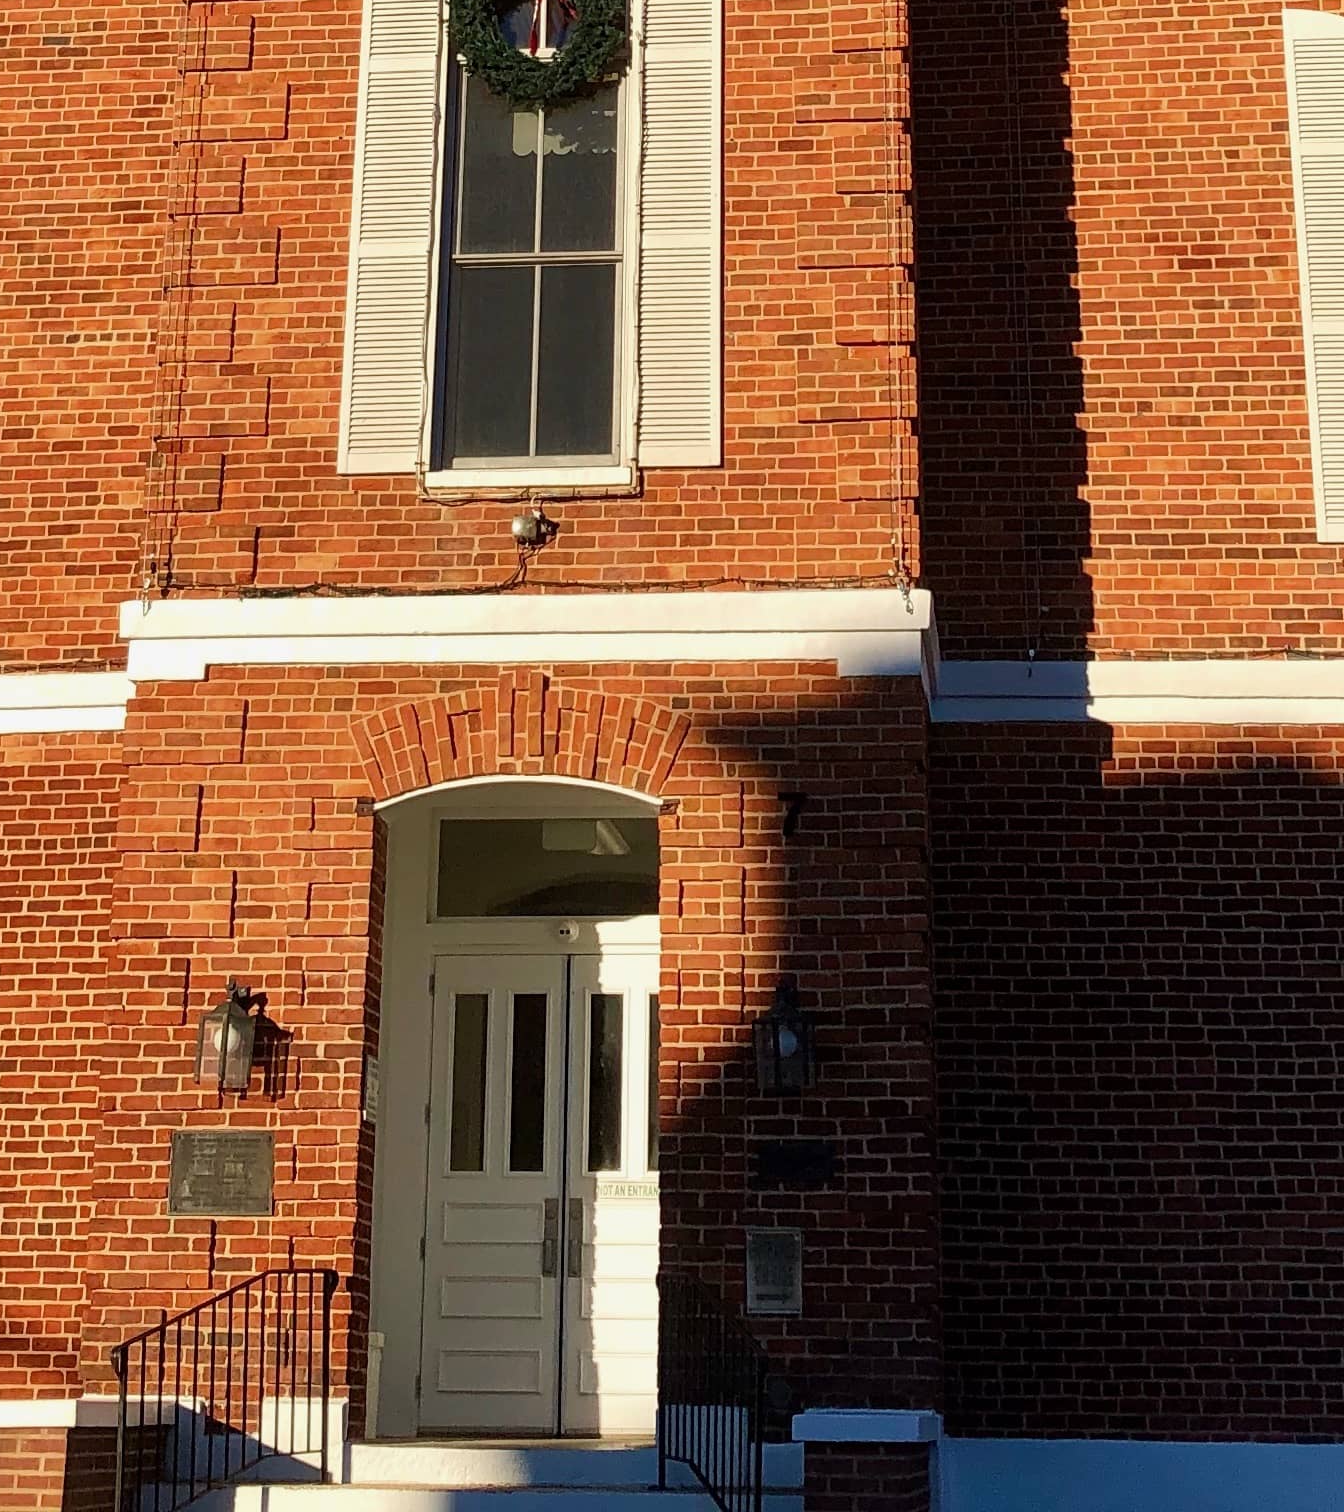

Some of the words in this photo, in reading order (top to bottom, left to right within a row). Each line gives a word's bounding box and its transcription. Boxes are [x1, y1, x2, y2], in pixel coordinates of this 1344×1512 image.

[596, 1184, 613, 1196] NOT
[615, 1184, 626, 1196] AN
[628, 1184, 658, 1196] ENTRAN
